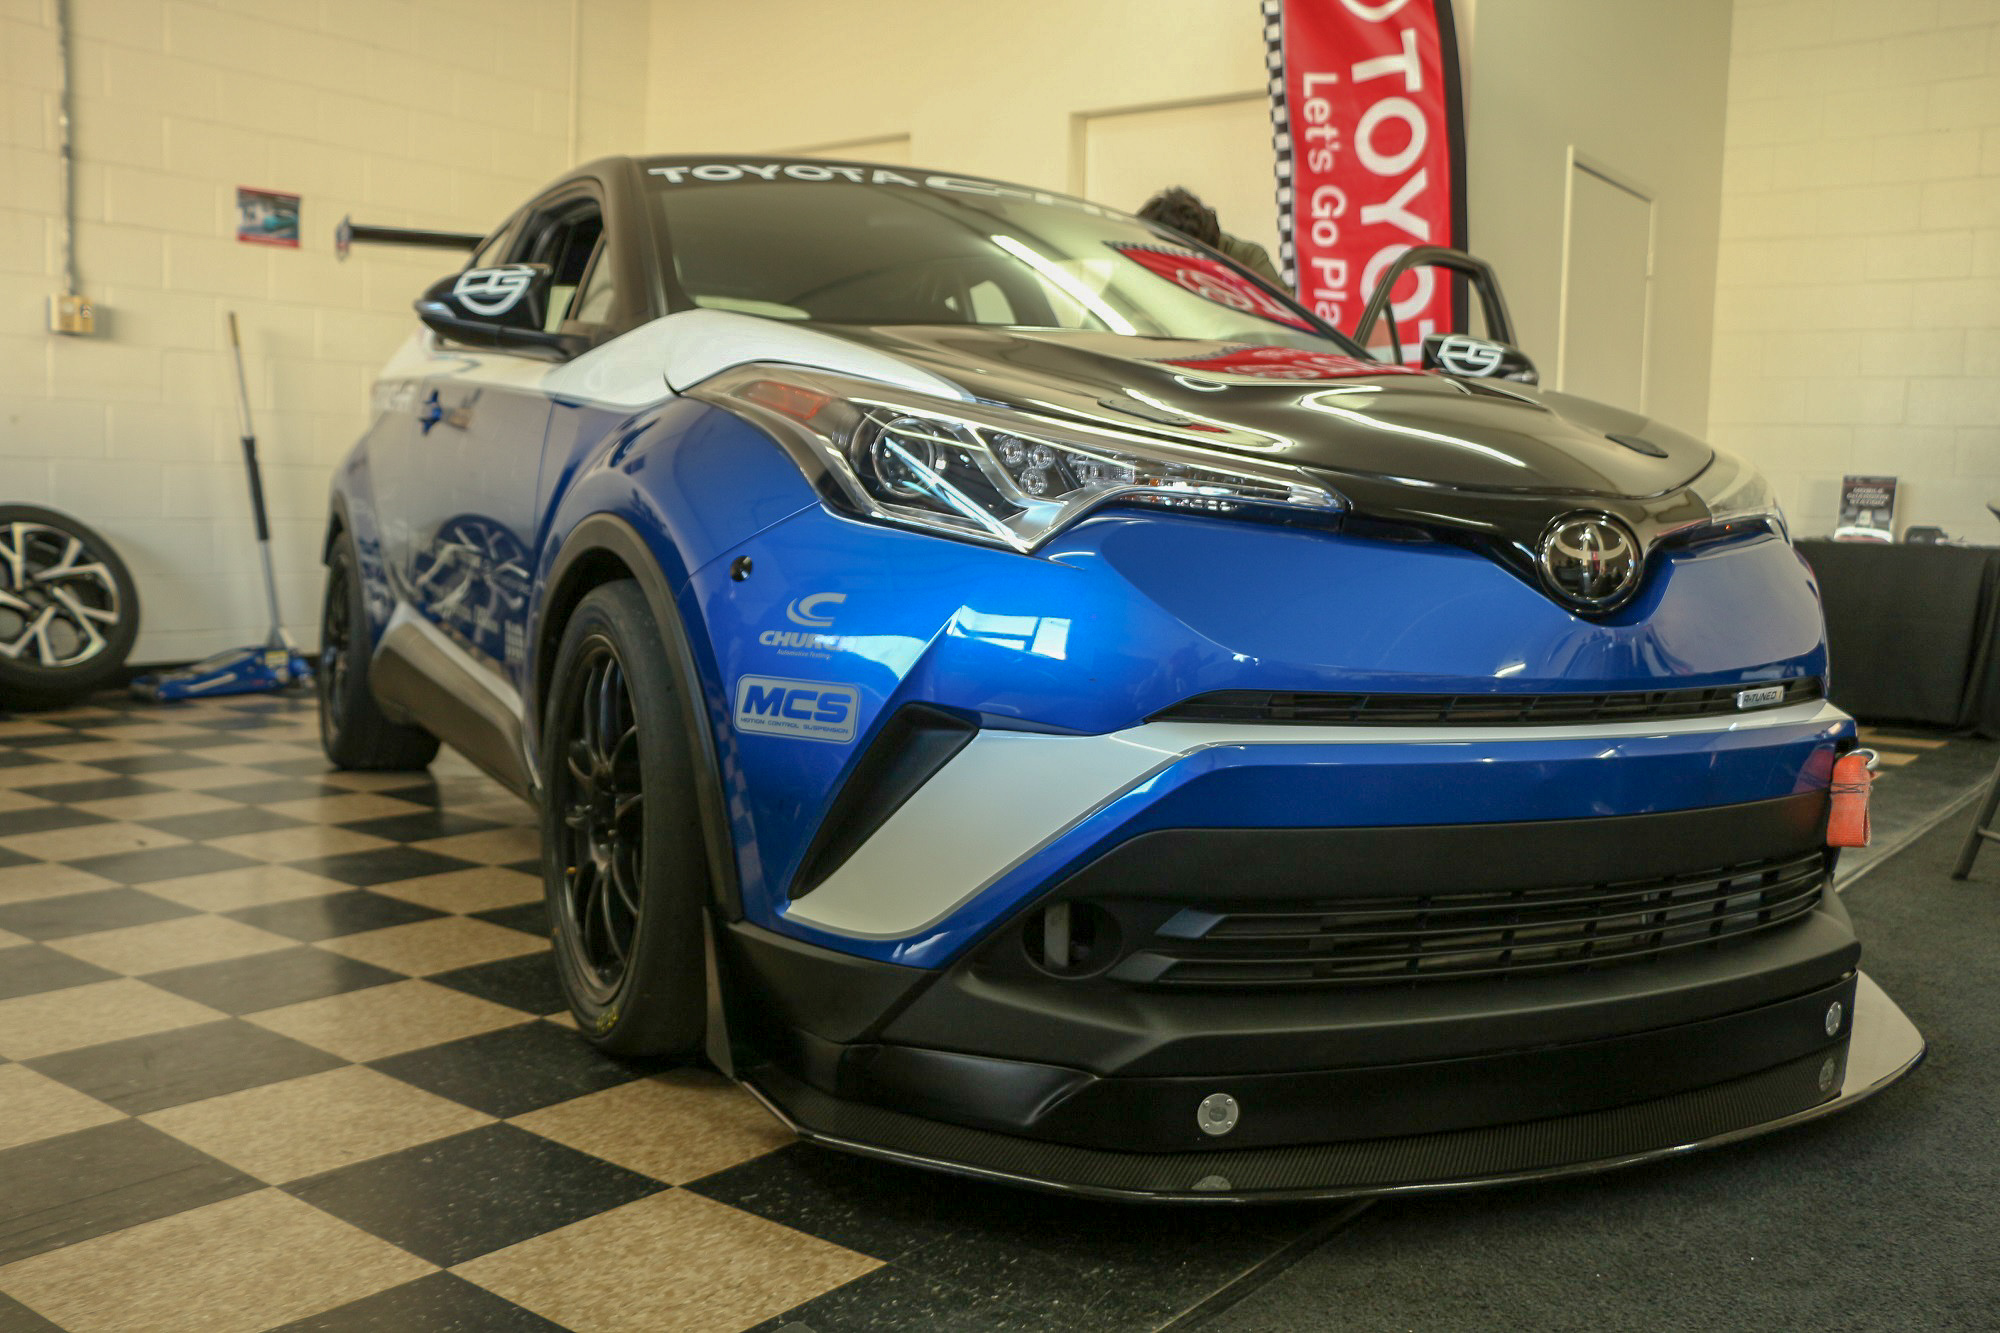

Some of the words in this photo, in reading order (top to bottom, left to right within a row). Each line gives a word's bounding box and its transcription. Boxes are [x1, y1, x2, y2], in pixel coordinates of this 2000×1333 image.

[1303, 72, 1341, 174] Let's
[648, 163, 919, 188] TOYOTA
[1311, 184, 1348, 248] Go
[742, 685, 852, 724] MCS
[740, 717, 765, 725] MOTION
[767, 720, 799, 729] CONTROL
[802, 724, 849, 735] SUSPENSION
